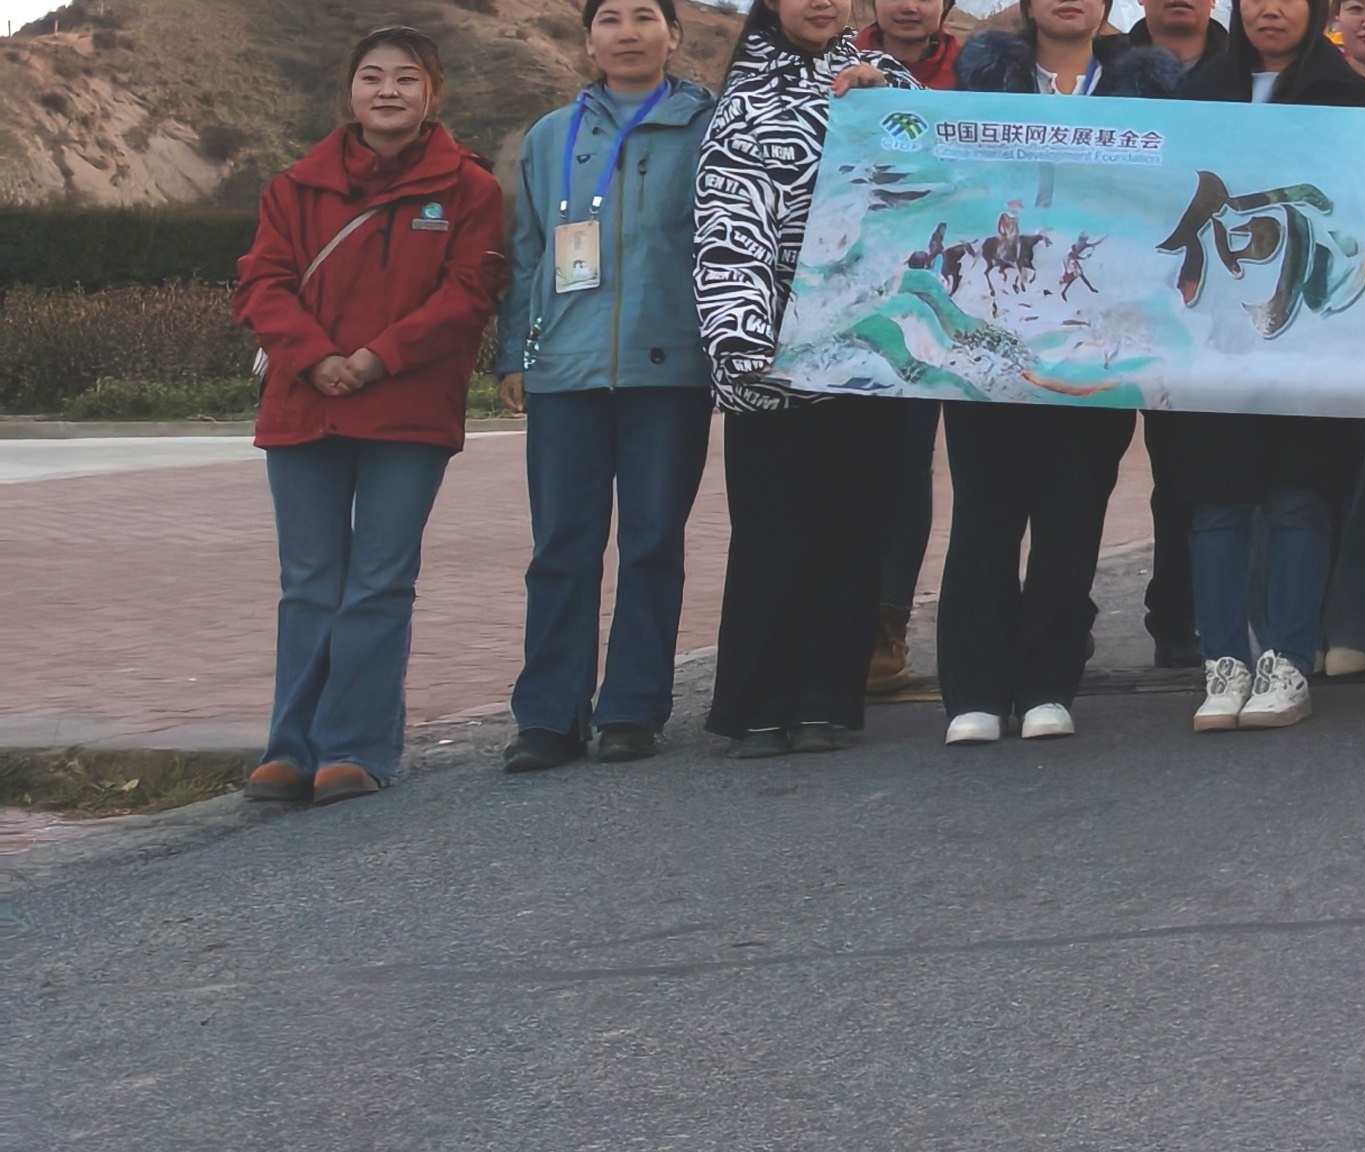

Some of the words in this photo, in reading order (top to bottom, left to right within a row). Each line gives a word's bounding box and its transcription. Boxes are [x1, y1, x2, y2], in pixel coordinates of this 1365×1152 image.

[936, 121, 1163, 149] 中国互联网发展基金会
